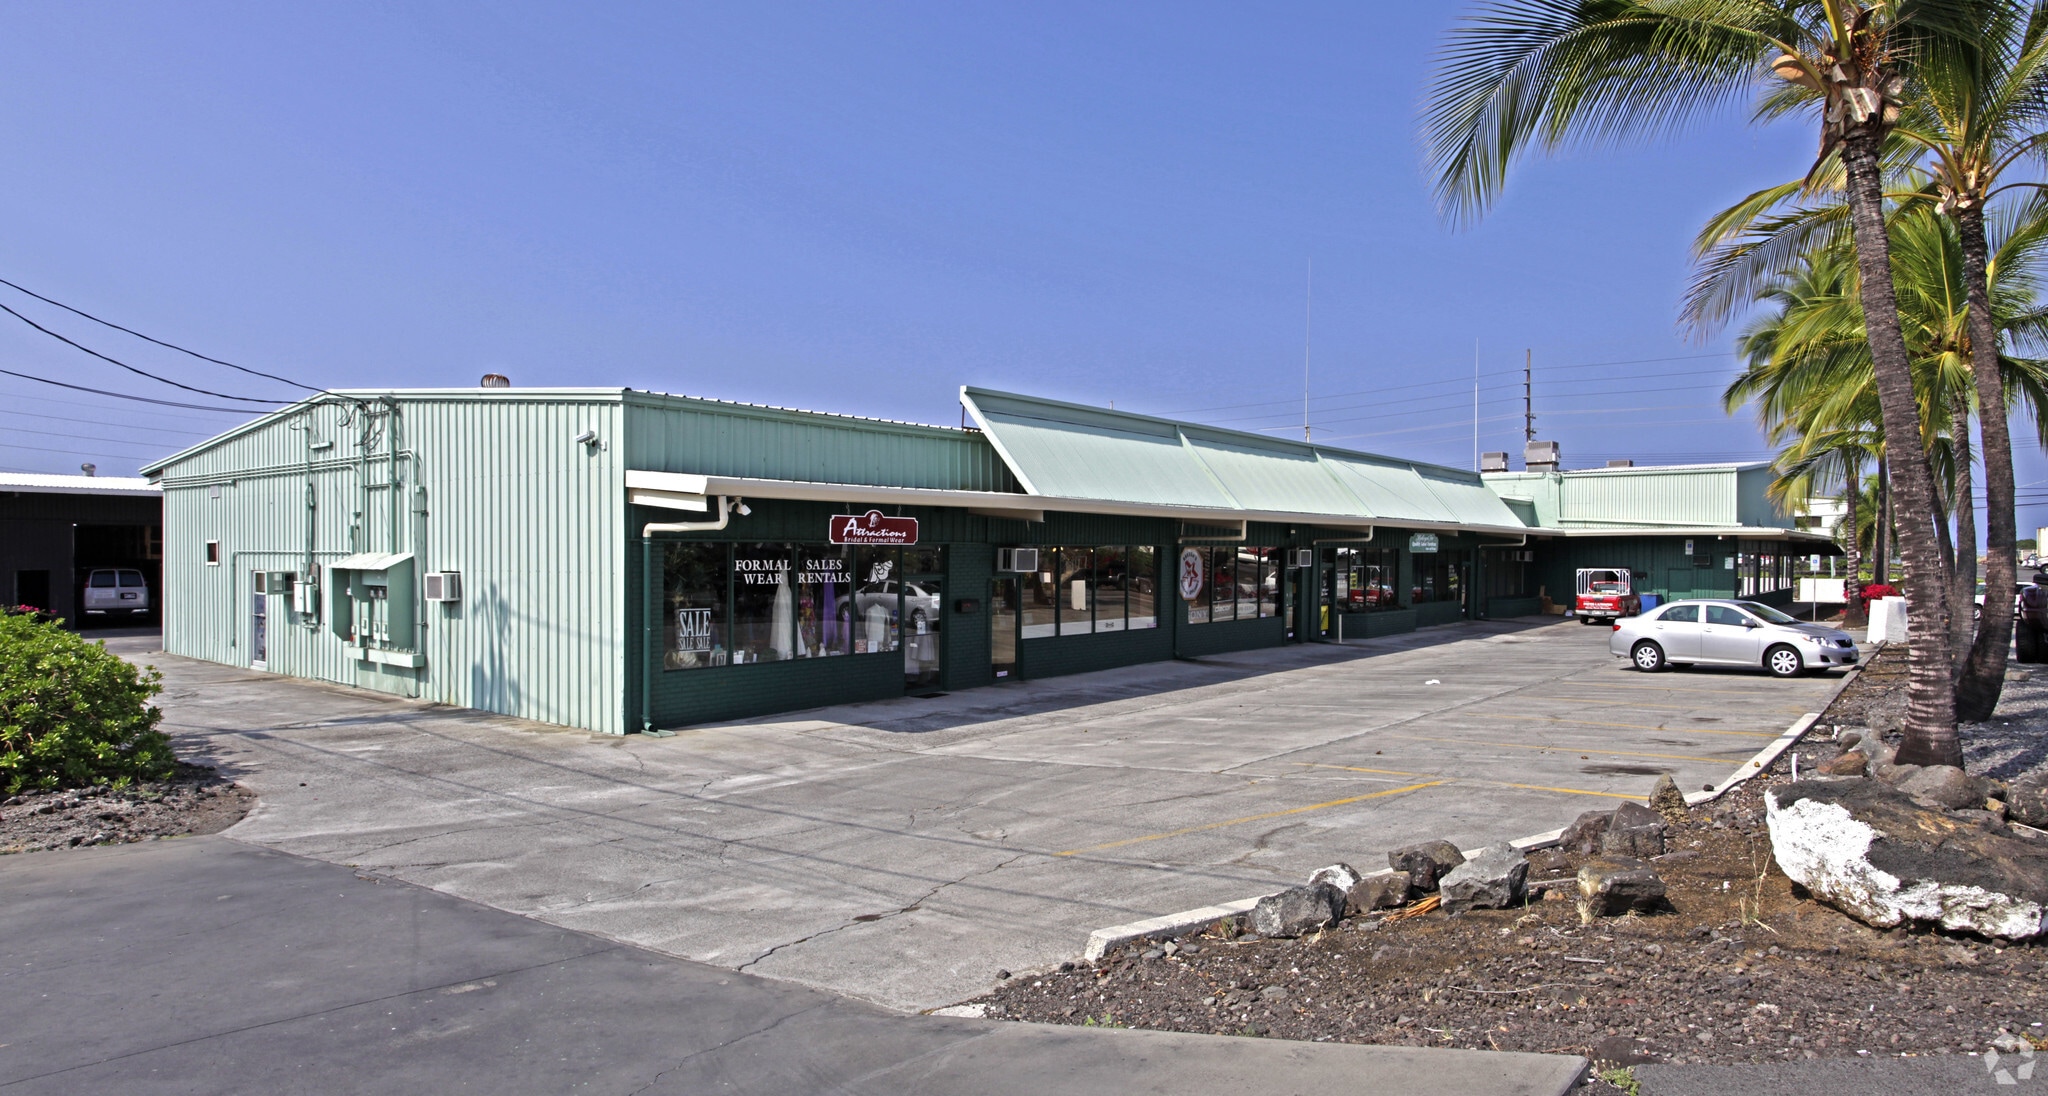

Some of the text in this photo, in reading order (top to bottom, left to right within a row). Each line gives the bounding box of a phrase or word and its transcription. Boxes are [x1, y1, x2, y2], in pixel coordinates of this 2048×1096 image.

[843, 517, 907, 538] Attractions
[735, 560, 791, 571] FORMAL
[806, 559, 843, 570] SALES
[743, 573, 783, 585] WEAR
[797, 572, 851, 584] RENTALS
[680, 610, 711, 637] SALE
[679, 636, 711, 650] SALE SALE
